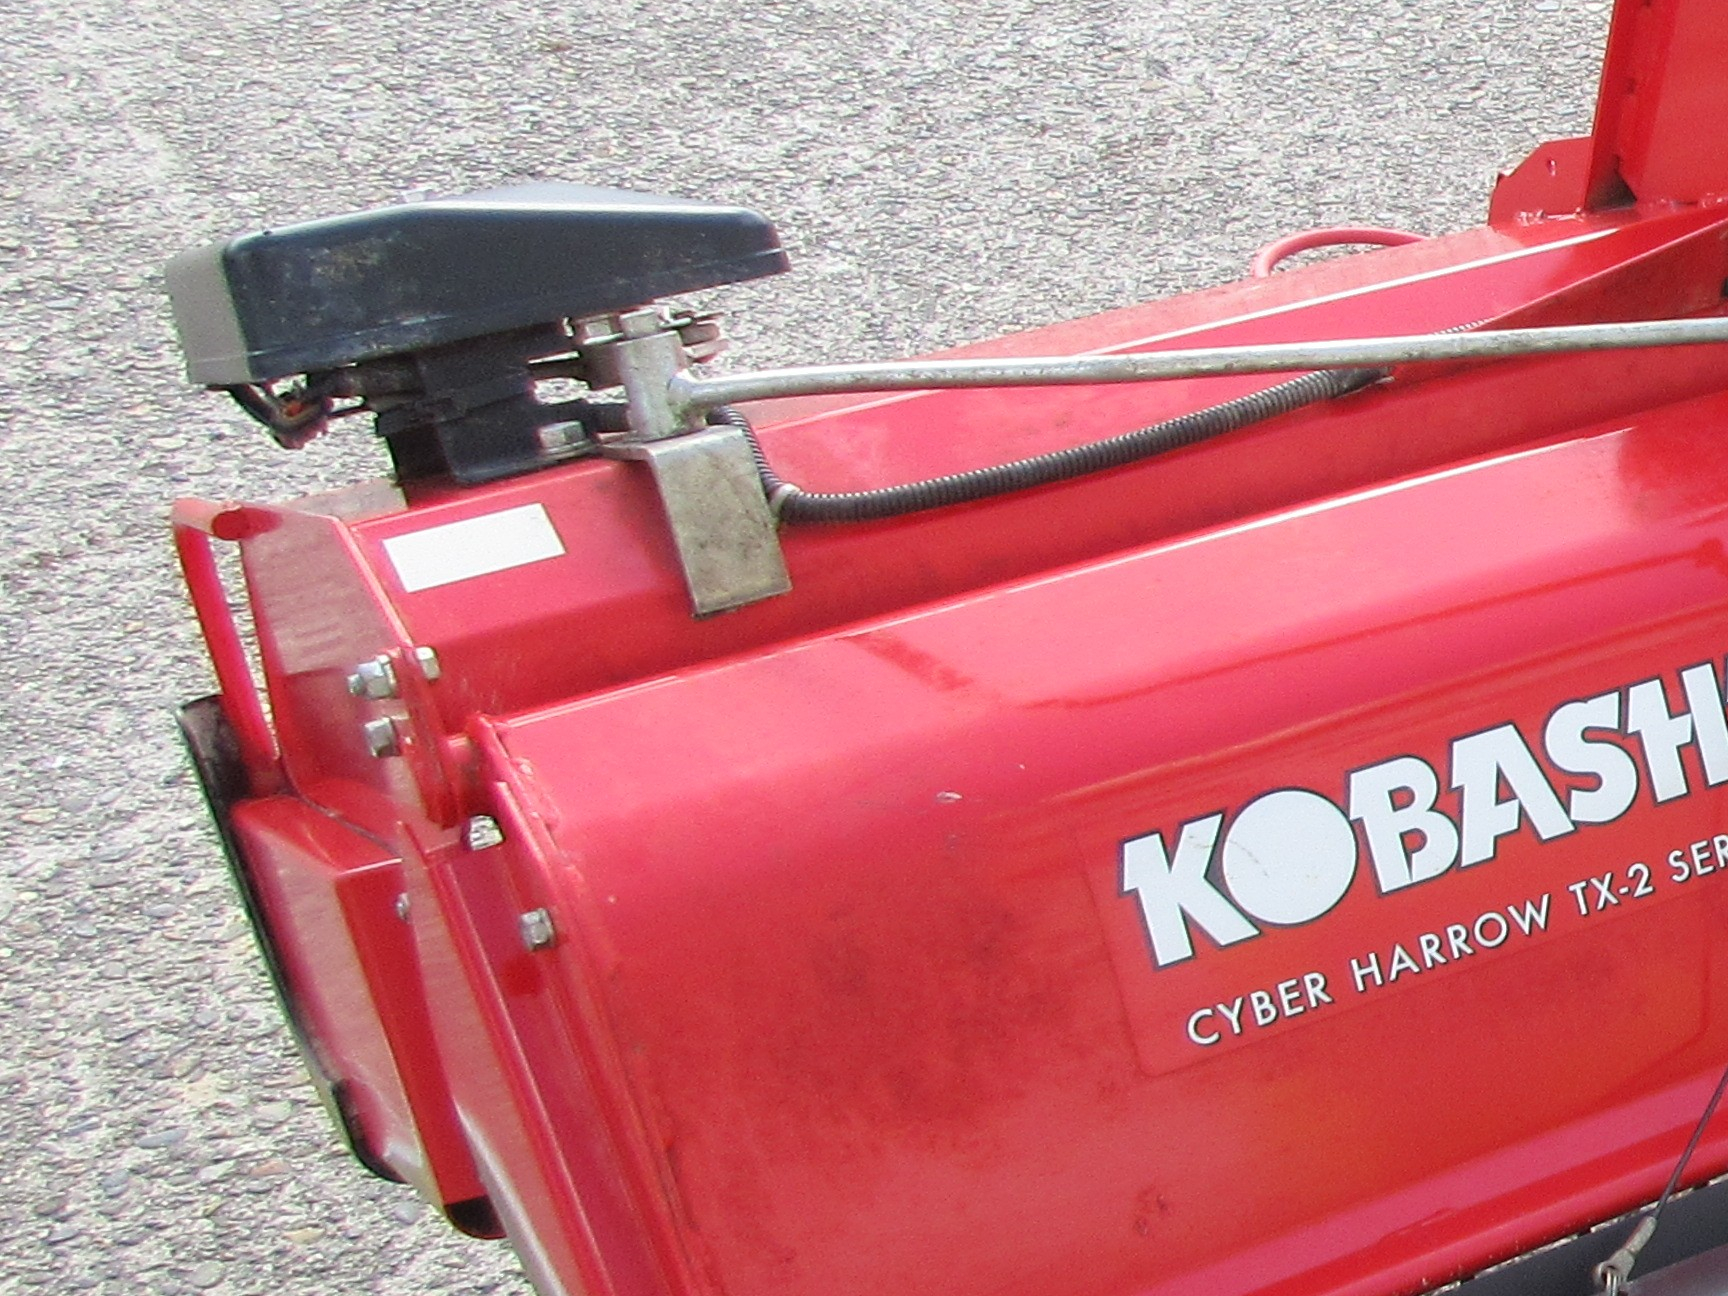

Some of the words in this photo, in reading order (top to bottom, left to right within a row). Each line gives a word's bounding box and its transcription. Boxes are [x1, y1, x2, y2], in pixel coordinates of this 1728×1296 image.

[1186, 972, 1332, 1048] CYBER
[1350, 893, 1552, 992] HARROW
[1568, 864, 1655, 919] TX-2
